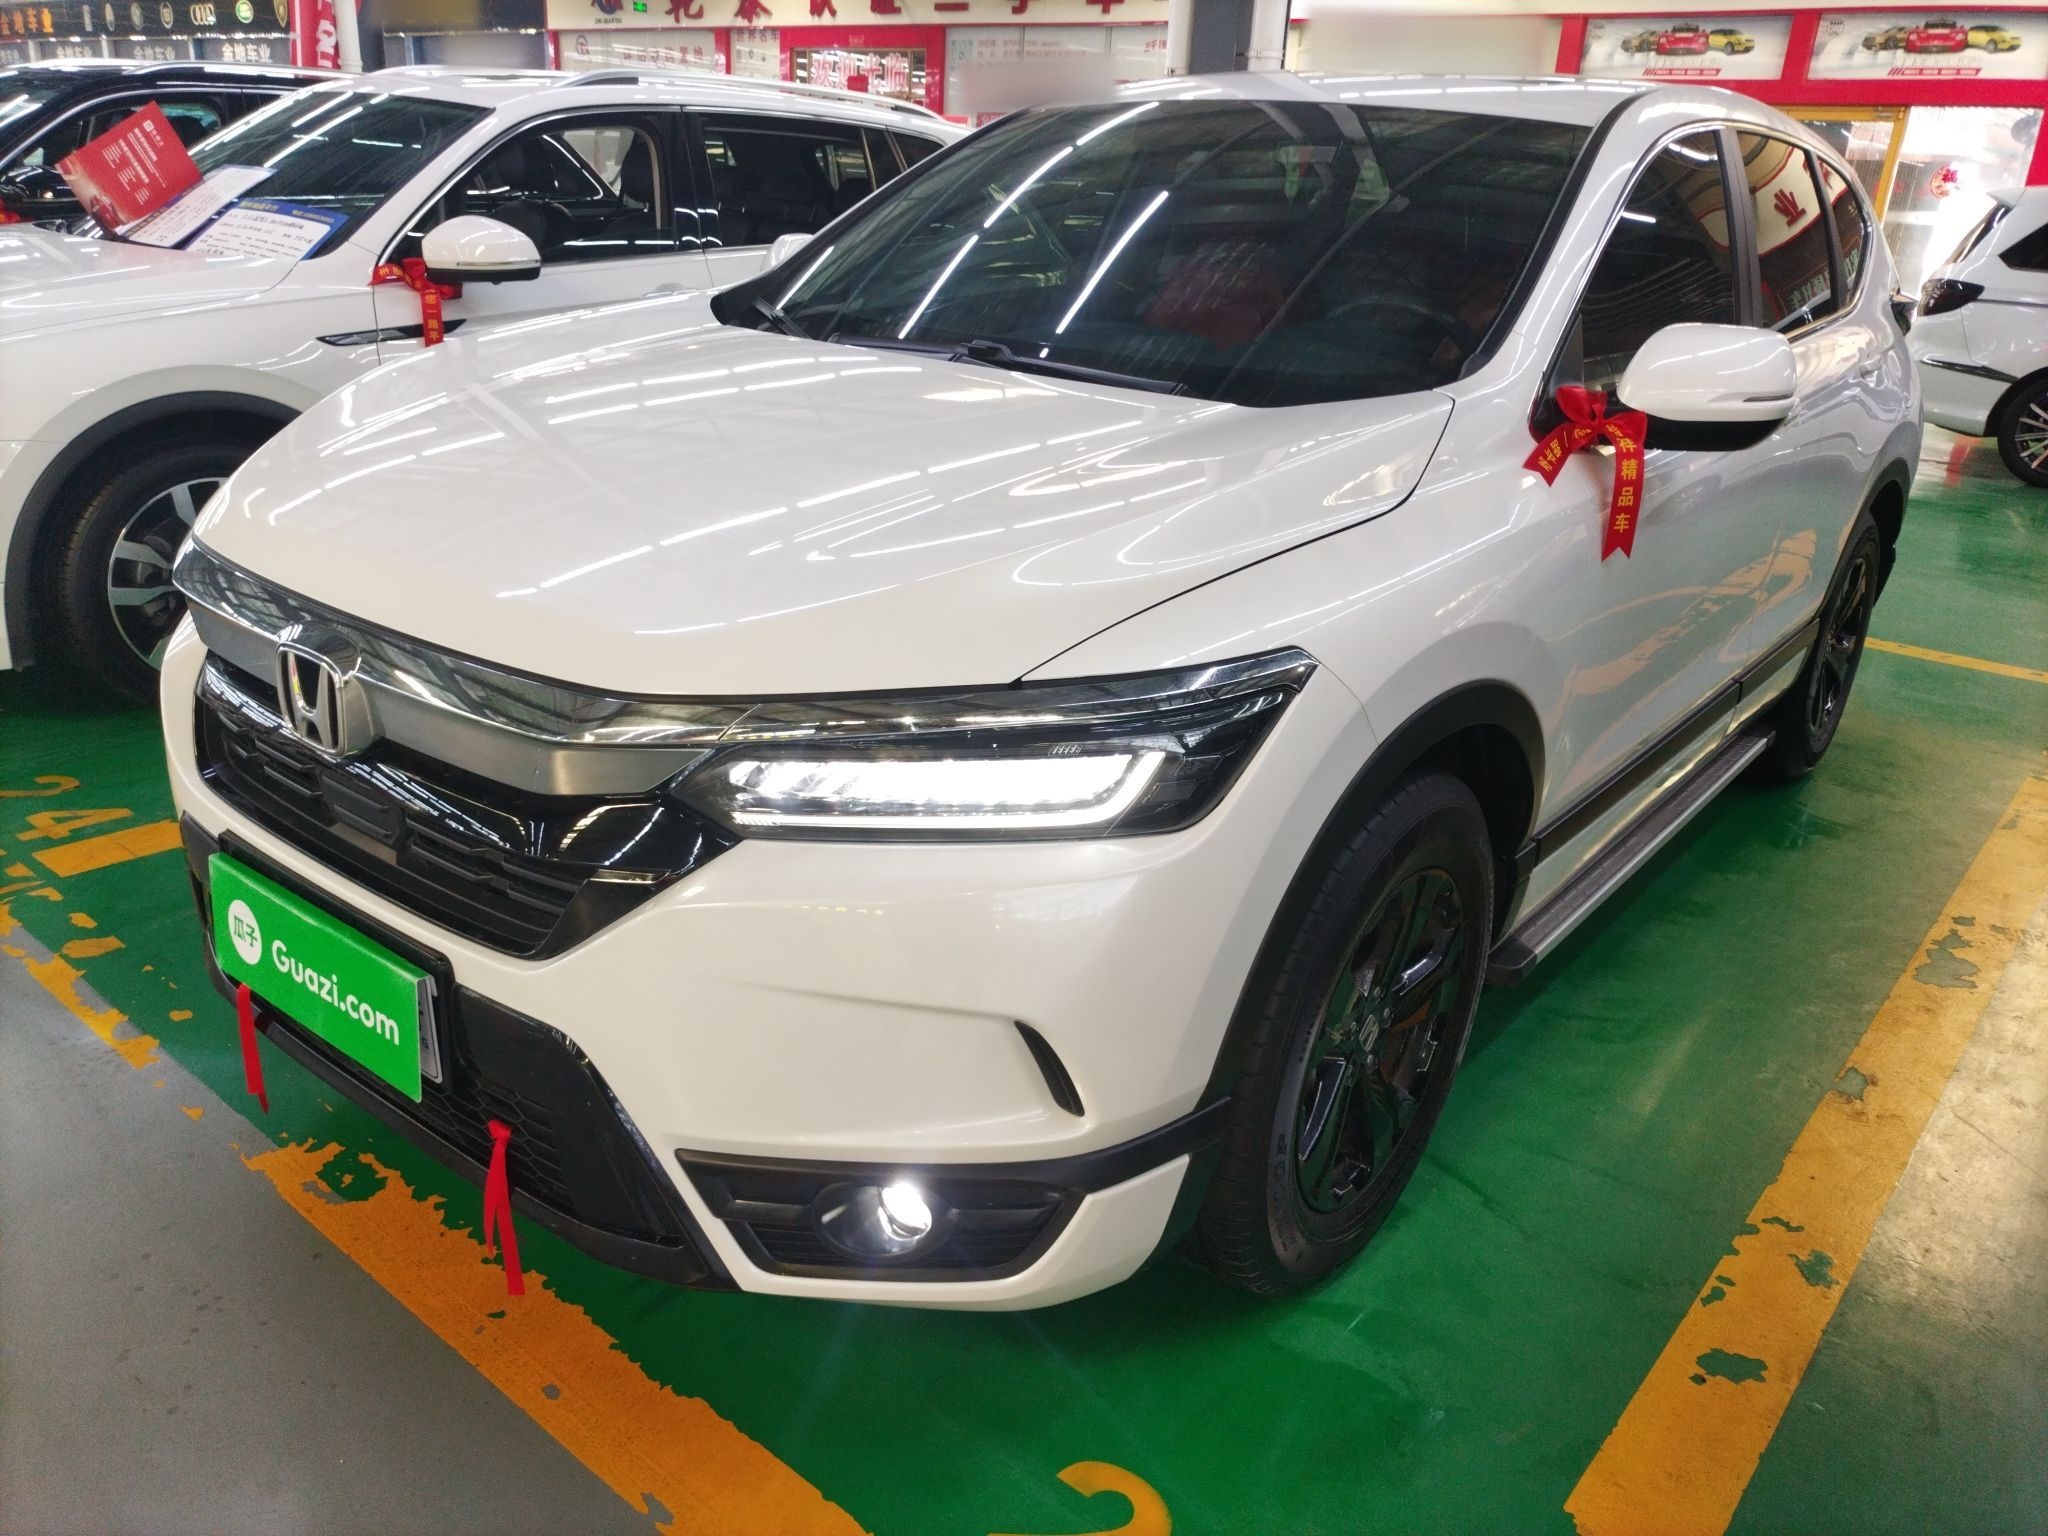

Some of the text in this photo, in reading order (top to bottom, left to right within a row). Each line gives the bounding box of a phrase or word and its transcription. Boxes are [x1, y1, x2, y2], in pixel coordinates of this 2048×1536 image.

[221, 44, 272, 62] 金地车业
[233, 915, 258, 948] 瓜子
[271, 939, 400, 1046] Guazi.com
